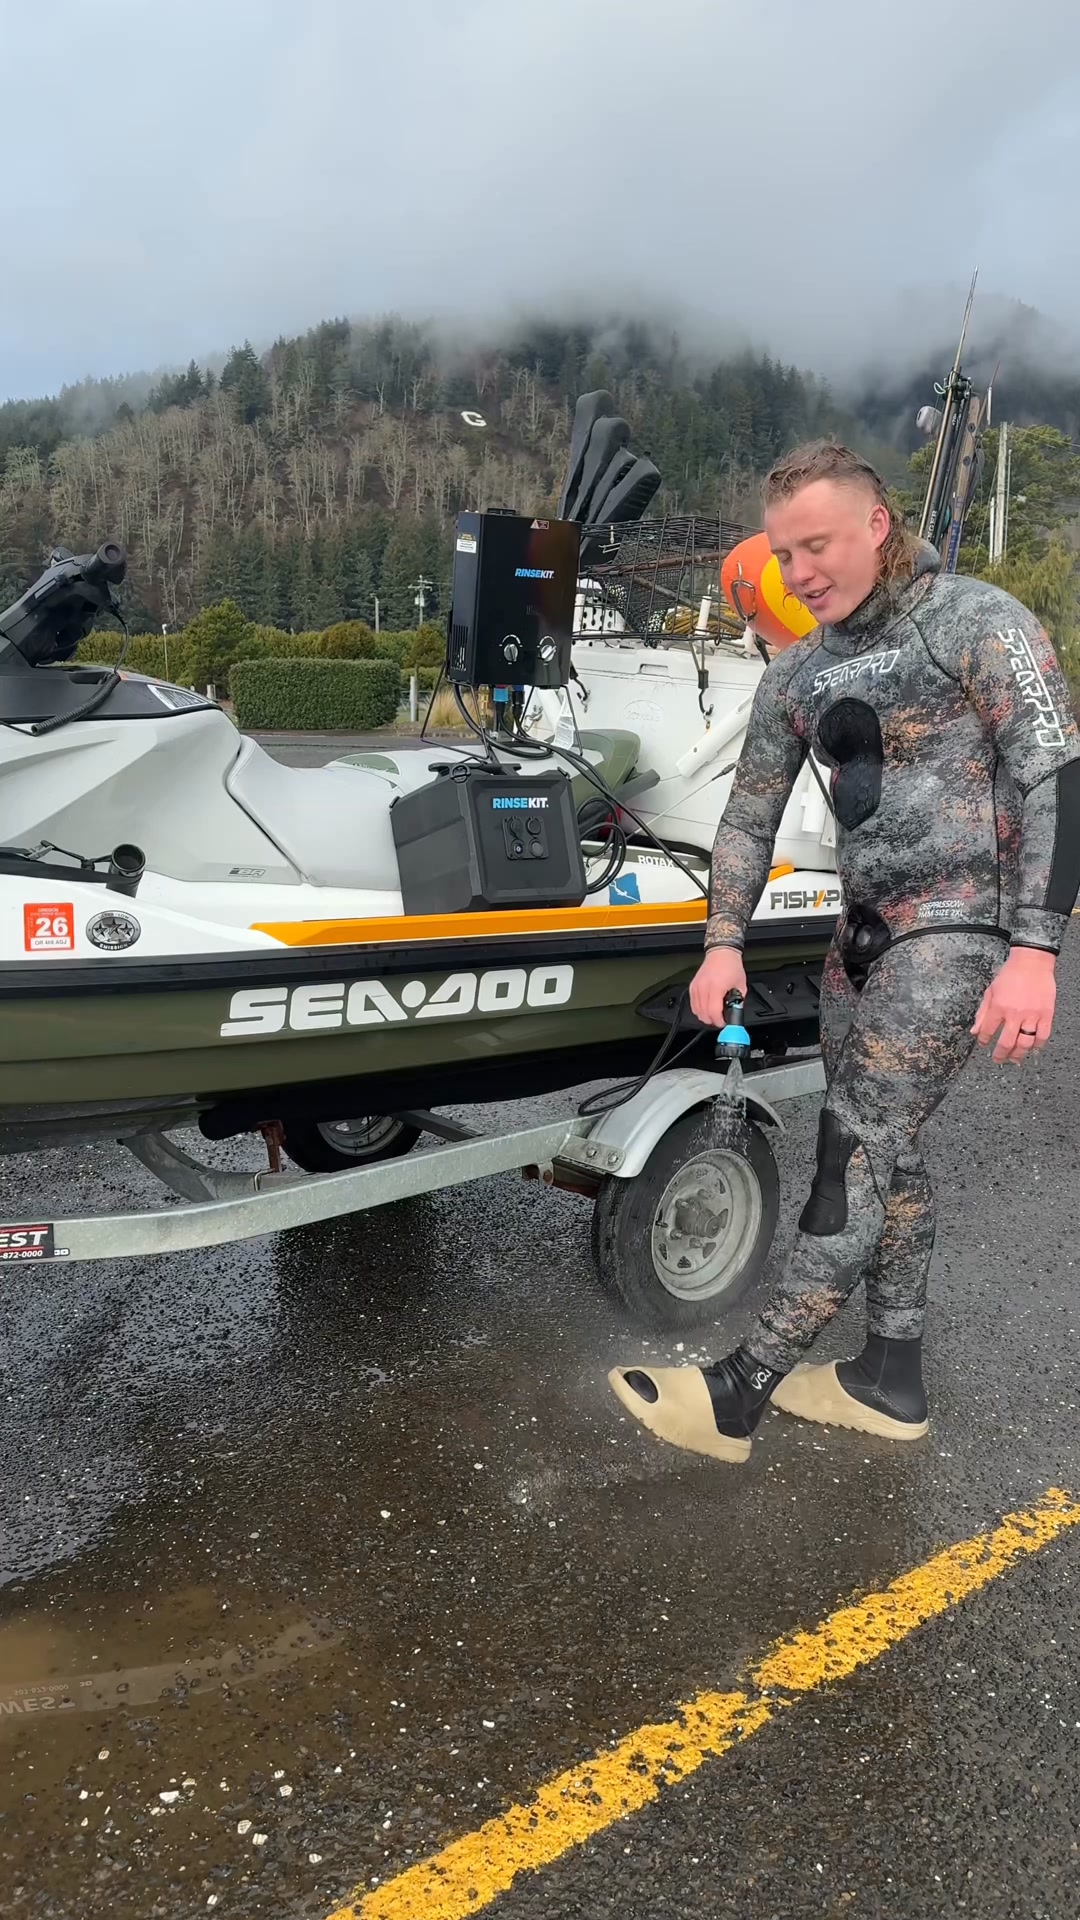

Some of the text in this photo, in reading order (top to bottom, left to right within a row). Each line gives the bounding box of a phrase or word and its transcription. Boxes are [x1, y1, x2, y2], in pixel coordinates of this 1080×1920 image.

[460, 410, 487, 427] G
[515, 567, 555, 579] RINSEKIT
[812, 649, 900, 695] SPEARPRO
[997, 627, 1065, 748] SPEARPRO
[492, 797, 549, 809] RINSEKIT
[637, 855, 675, 868] ROTAX
[935, 909, 949, 917] SIZE
[35, 916, 69, 937] 26
